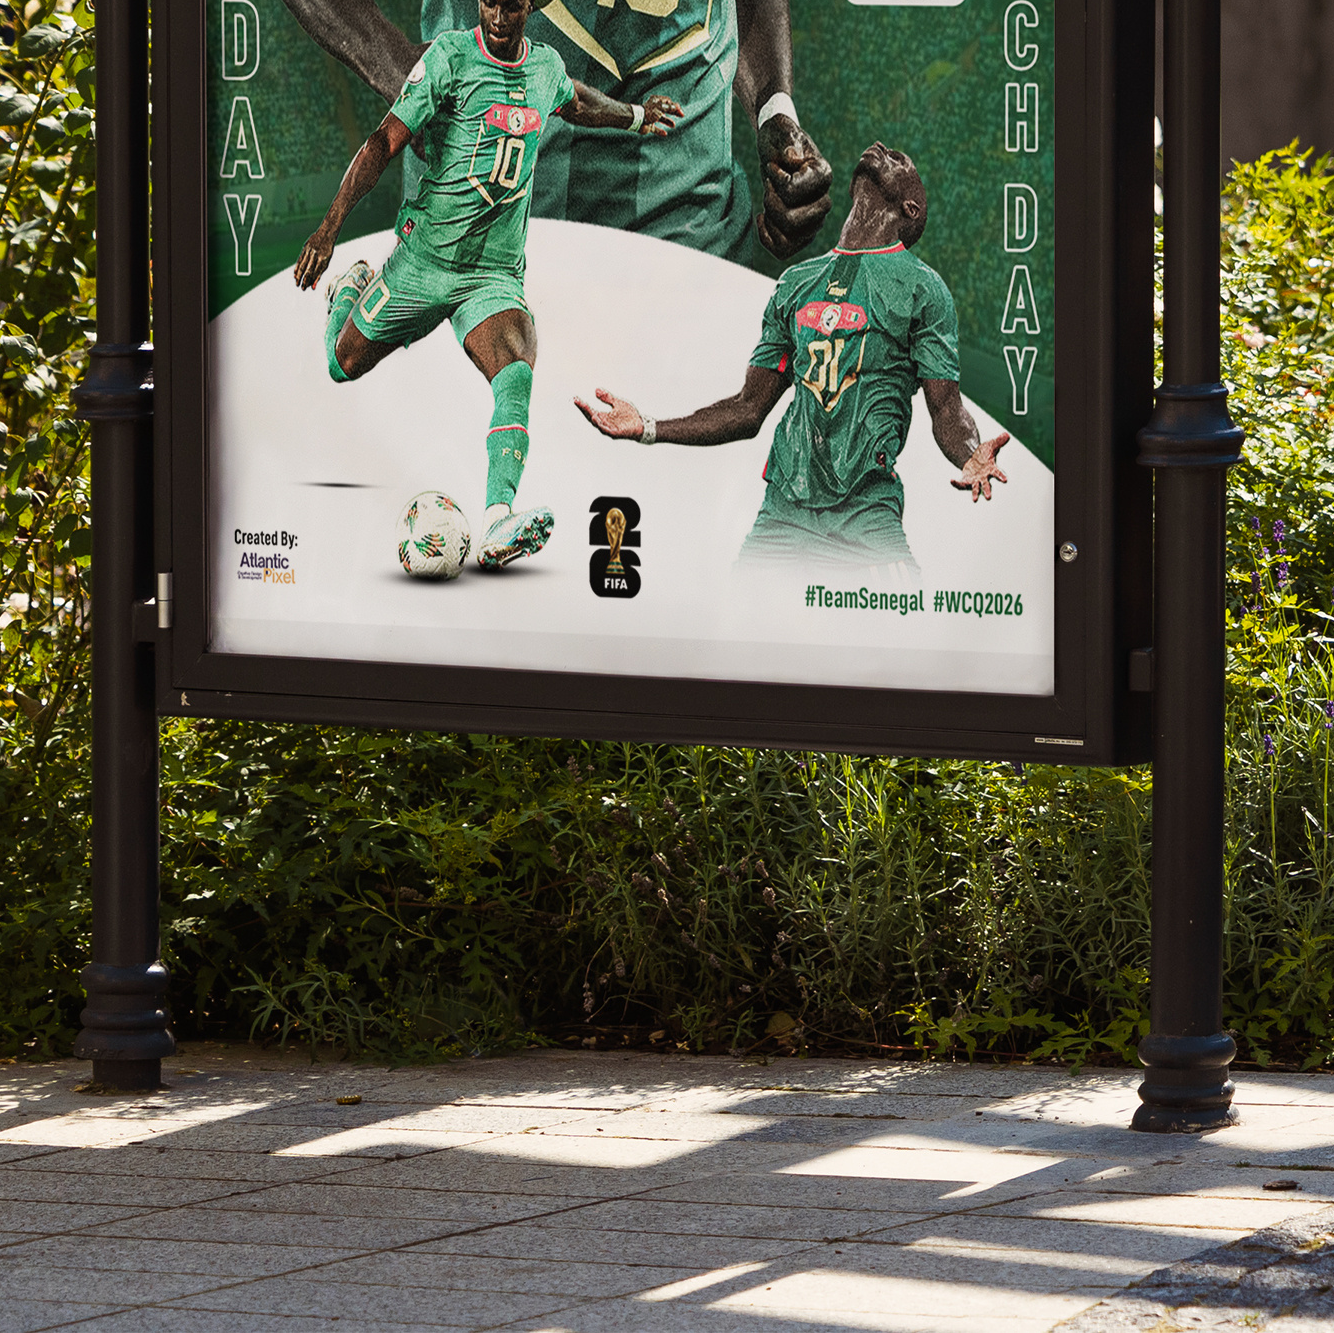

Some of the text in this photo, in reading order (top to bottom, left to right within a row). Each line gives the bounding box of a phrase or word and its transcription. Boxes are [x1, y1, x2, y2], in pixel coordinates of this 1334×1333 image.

[488, 136, 526, 190] 10
[1001, 183, 1040, 415] DAY
[234, 528, 298, 550] Created By:
[240, 552, 289, 569] Atlantic
[263, 568, 296, 584] Pixel
[604, 577, 628, 590] FIFA
[805, 585, 1024, 617] #TeamSenegal #WCQ2026
